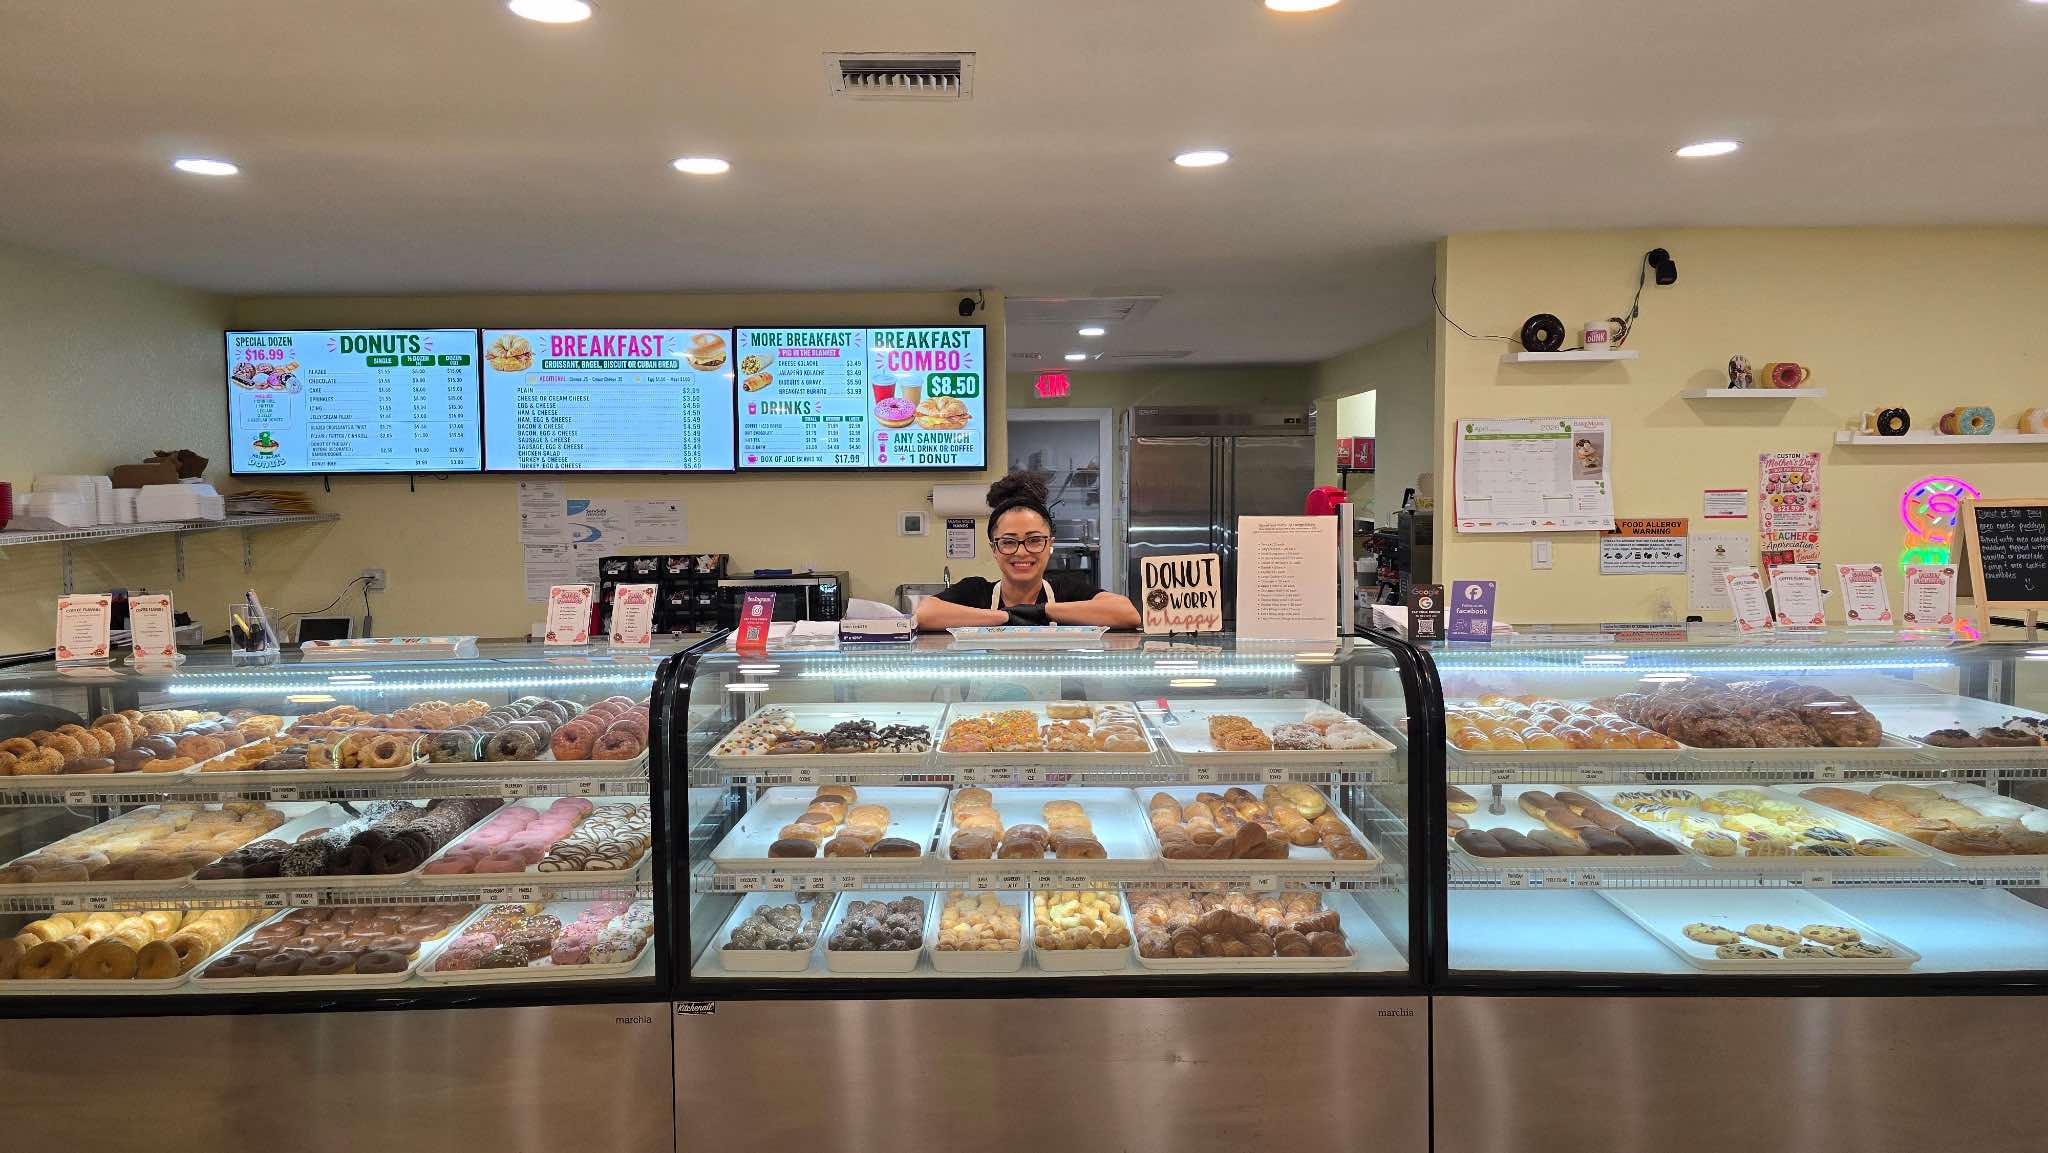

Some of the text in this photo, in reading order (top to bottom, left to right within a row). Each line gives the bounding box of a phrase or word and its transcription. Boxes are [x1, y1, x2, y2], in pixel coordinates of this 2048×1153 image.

[236, 336, 292, 347] SPECIAL DOZEN
[340, 335, 420, 354] DONUTS
[751, 332, 852, 346] MORE BREAKFAST
[874, 331, 970, 348] BREAKFAST
[550, 335, 664, 357] BREAKFAST
[245, 348, 284, 360] $16.99
[658, 360, 678, 369] BREAD
[888, 350, 960, 372] COMBO
[932, 376, 976, 396] $8.50
[761, 401, 811, 414] DRINKS
[894, 432, 970, 444] ANY SANDWICH
[835, 454, 860, 464] $17.99
[920, 454, 958, 464] DONUT
[1766, 459, 1798, 467] Mother's
[2019, 522, 2045, 534] pudding
[1766, 532, 1807, 540] TEACHER
[1767, 542, 1814, 551] Appreciation
[1146, 558, 1215, 589] DONUT
[1170, 590, 1218, 610] WORRY
[1162, 609, 1220, 630] happy
[1378, 1008, 1414, 1016] marchia
[616, 1016, 652, 1024] marchia
